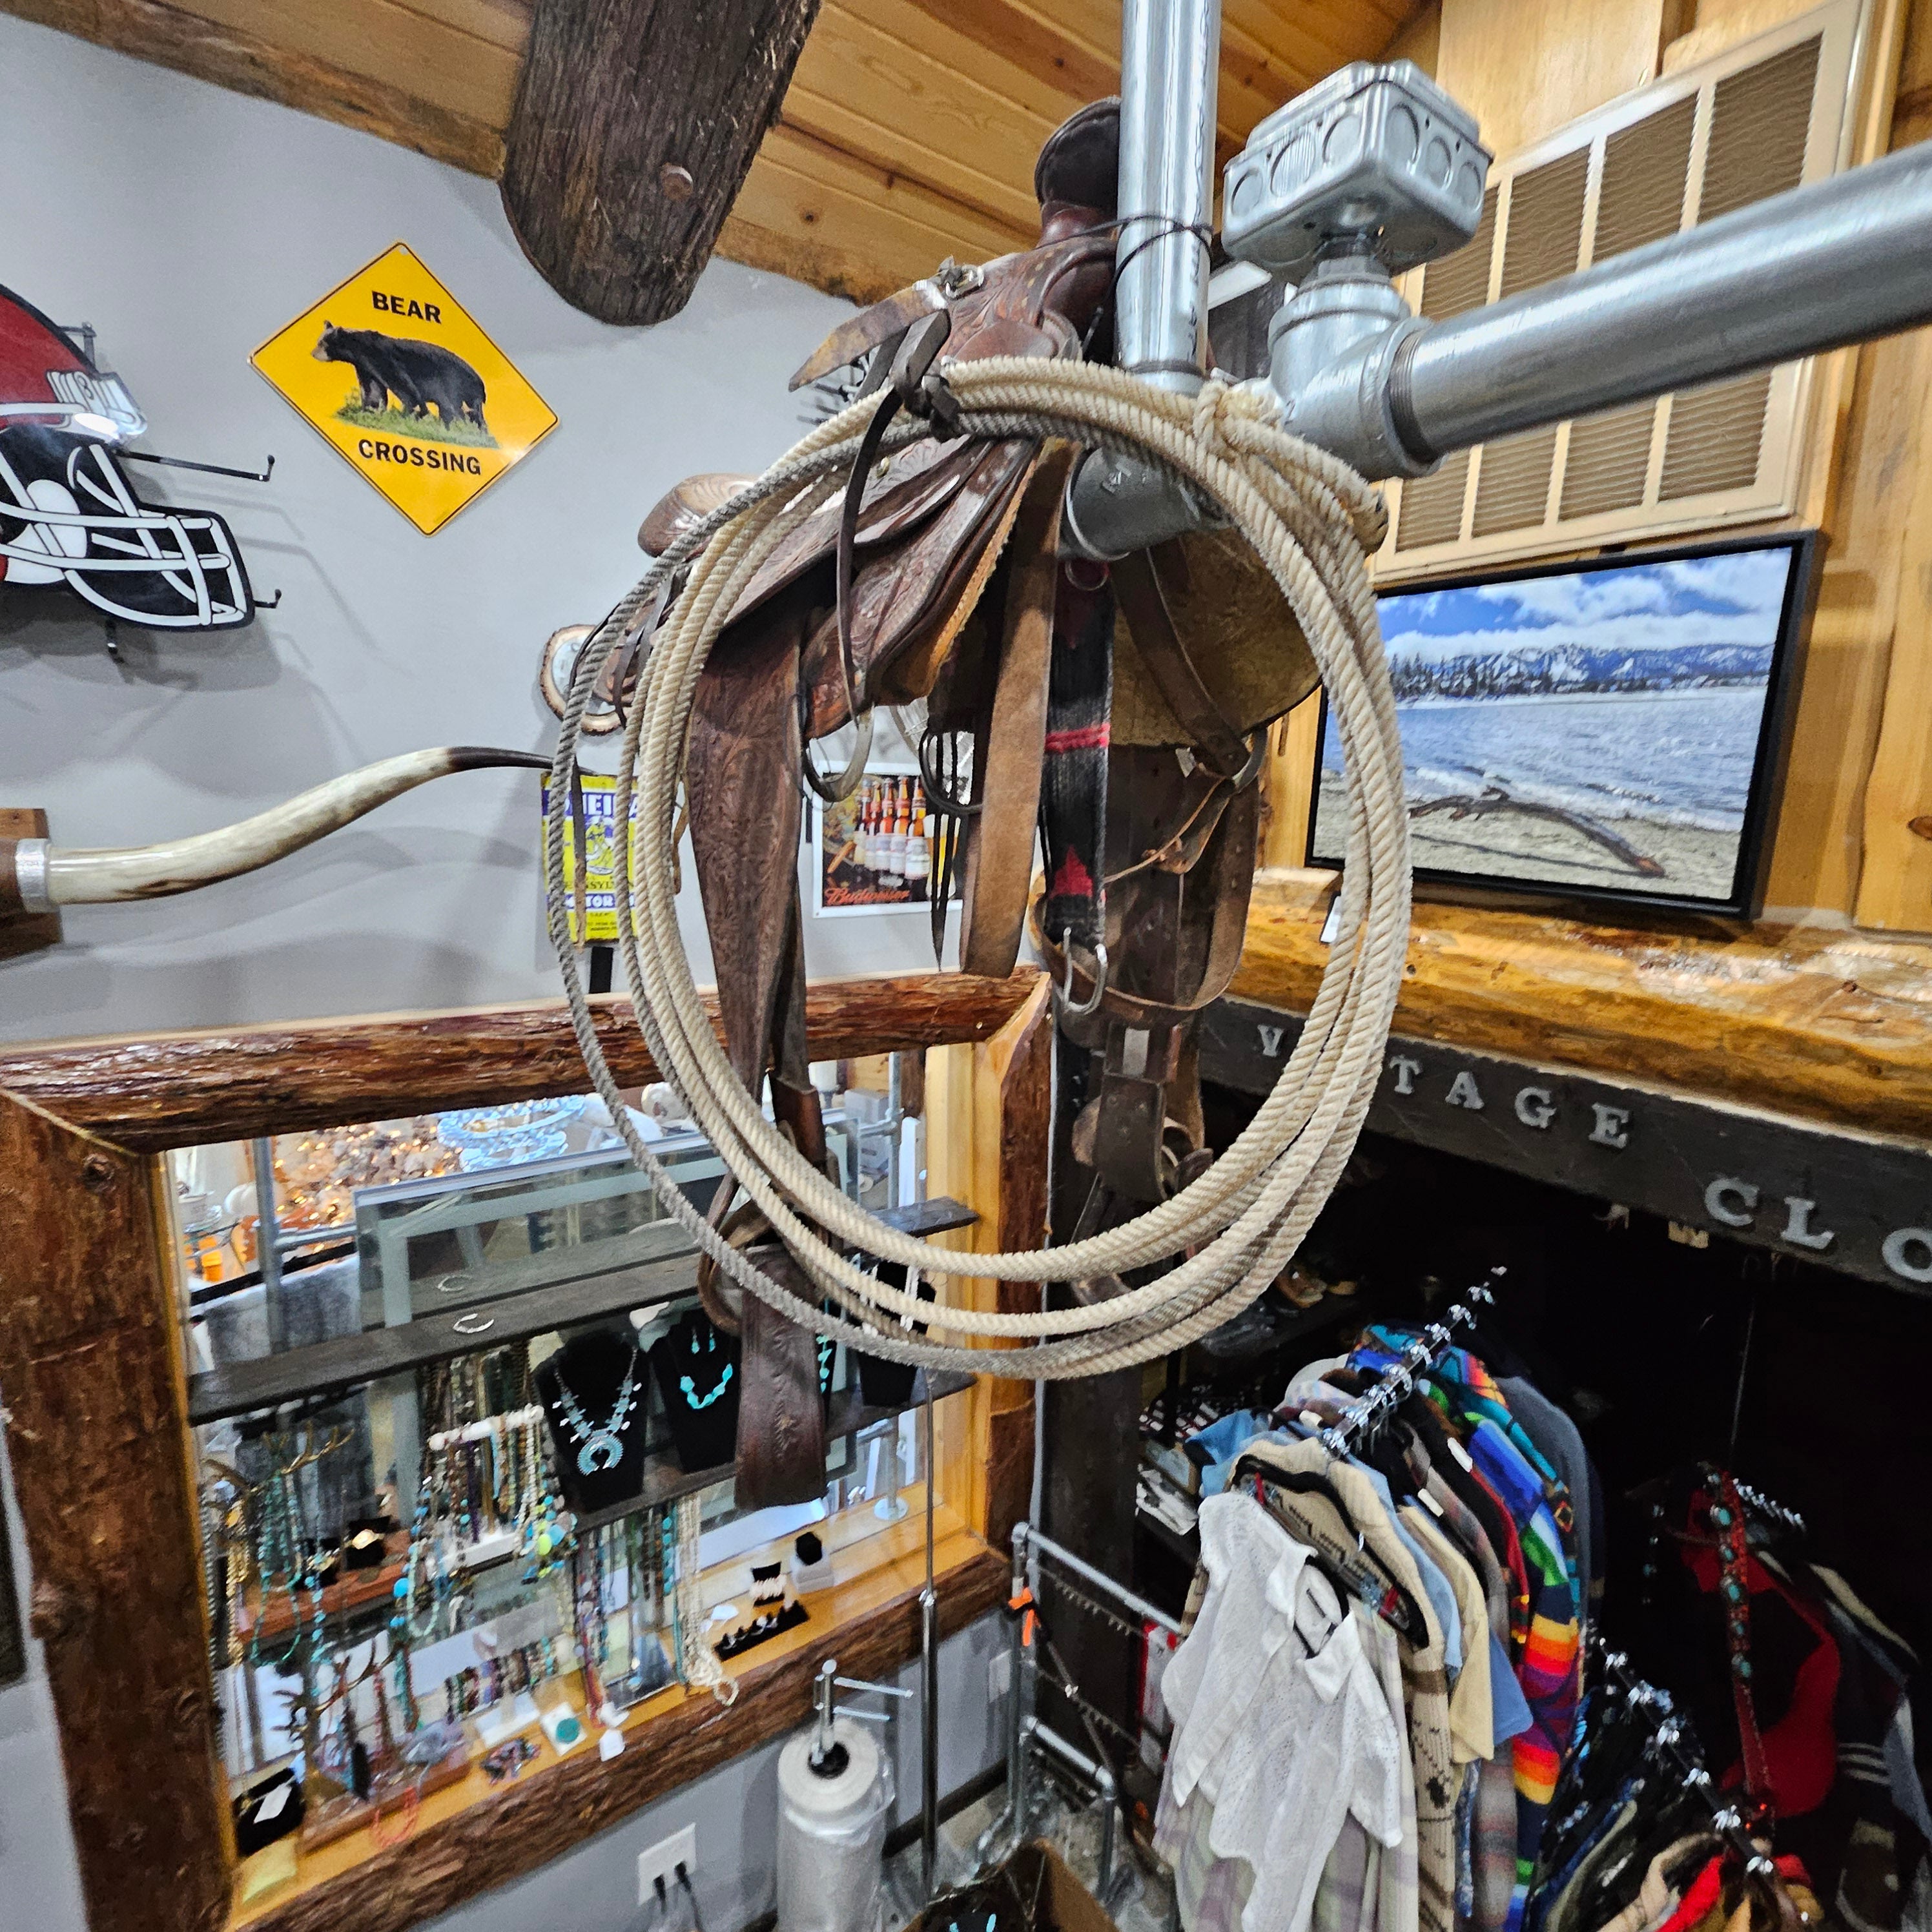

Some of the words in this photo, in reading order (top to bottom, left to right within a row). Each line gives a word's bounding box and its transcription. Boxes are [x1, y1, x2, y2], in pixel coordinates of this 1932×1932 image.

[372, 291, 442, 324] BEAR
[358, 439, 481, 475] CROSSING
[1257, 1024, 1630, 1149] VTAGE
